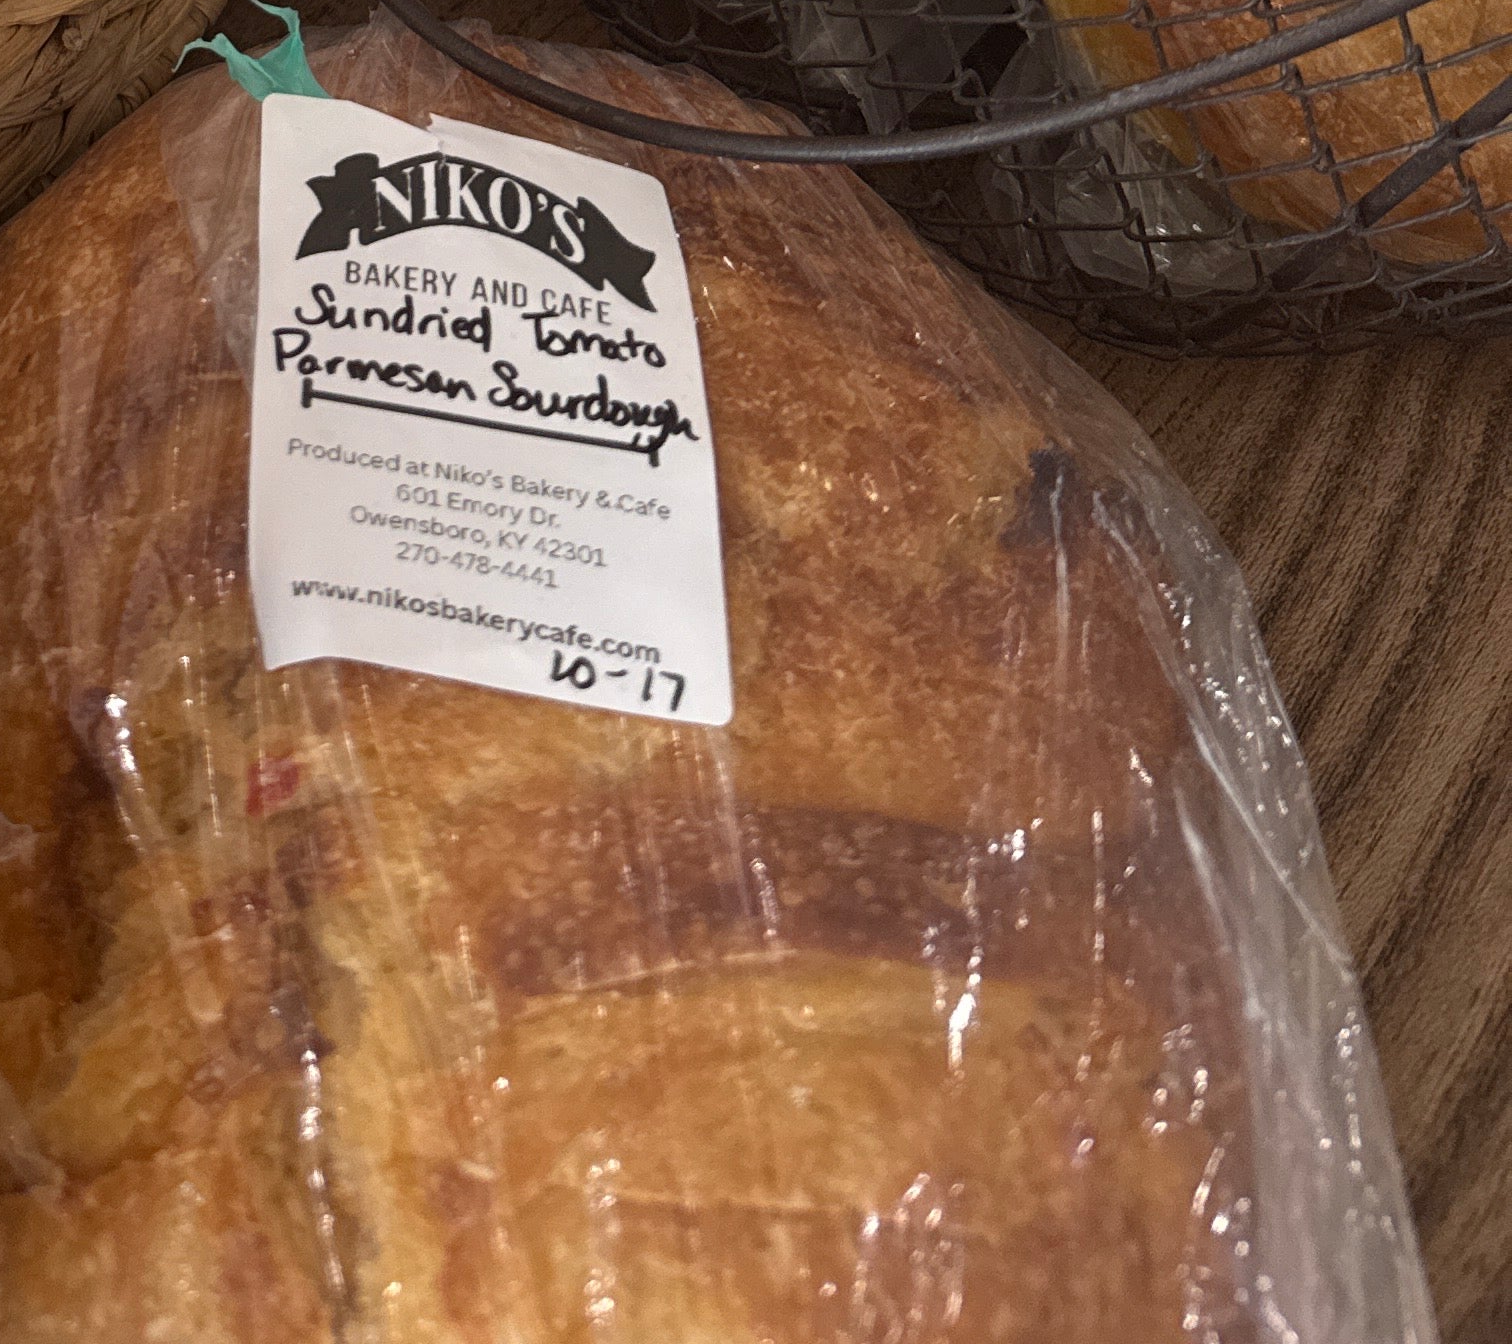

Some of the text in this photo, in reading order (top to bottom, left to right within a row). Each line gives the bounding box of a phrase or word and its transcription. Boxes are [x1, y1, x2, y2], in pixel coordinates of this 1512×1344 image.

[371, 160, 586, 264] NIKO'S
[294, 283, 667, 368] Sundried Tomato
[345, 260, 612, 325] BAKERY AND CAFE
[273, 327, 699, 452] Parmesan Sourdough
[288, 437, 671, 520] Produced at Niko's Bakery & Cafe
[396, 483, 561, 528] 601 Emory Dr.
[349, 505, 607, 568] Owensboro, KY 42301
[396, 541, 559, 589] 270-478-4441
[291, 579, 662, 663] www.nikosbakerycafe.com
